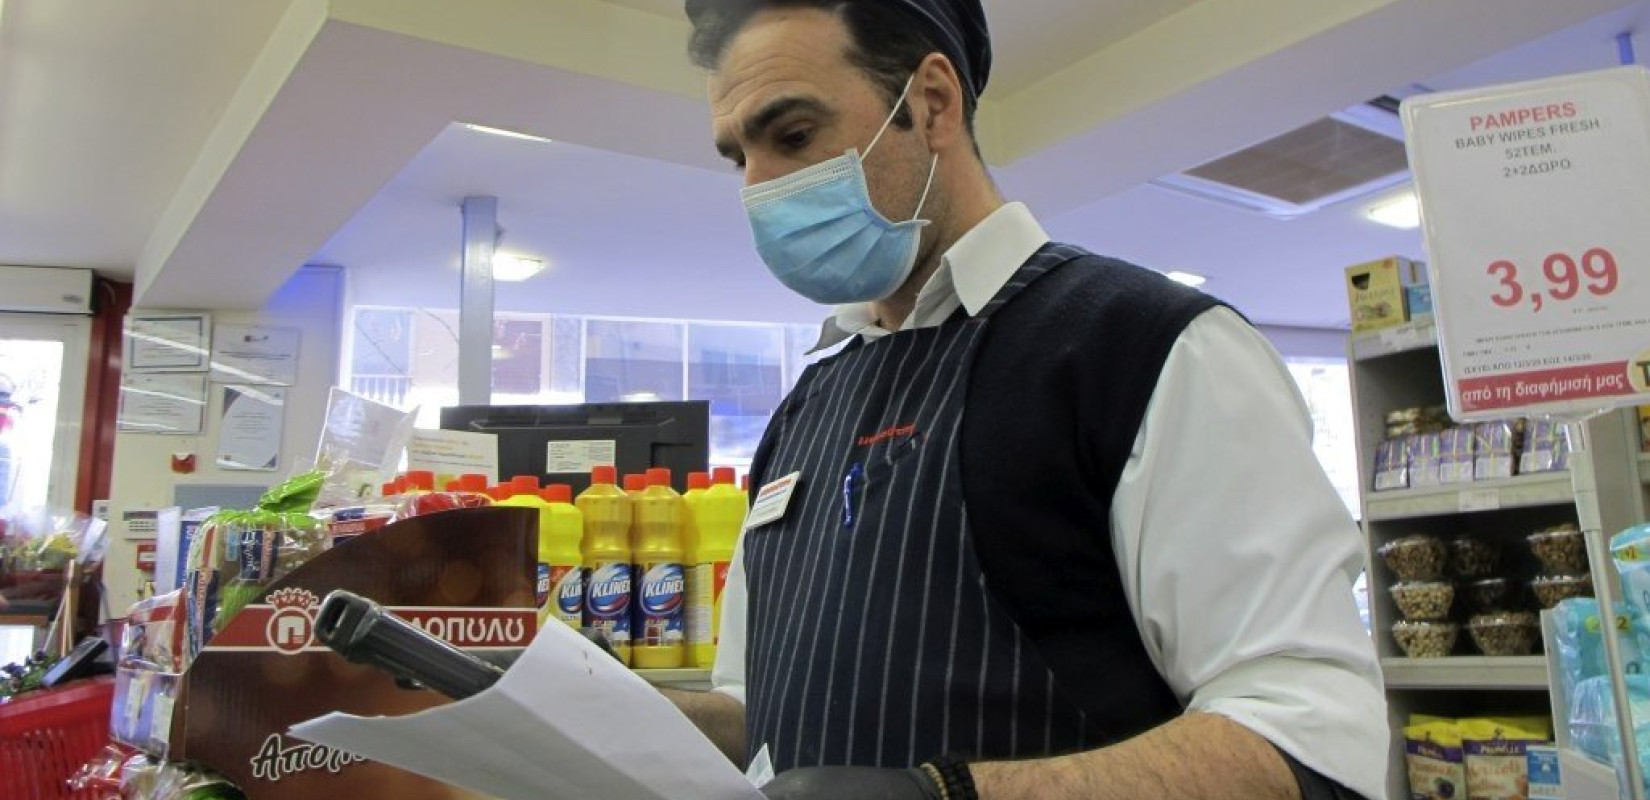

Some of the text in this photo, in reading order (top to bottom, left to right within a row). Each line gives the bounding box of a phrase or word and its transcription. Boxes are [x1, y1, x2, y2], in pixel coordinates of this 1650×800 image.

[1470, 102, 1577, 131] PAMPERS
[1455, 118, 1600, 149] BABY WIPES FRESH
[1503, 159, 1571, 177] 2+2ΔΩΡΟ
[1487, 247, 1619, 313] 3,99
[1462, 373, 1624, 401] από τη διαφήμισή μας
